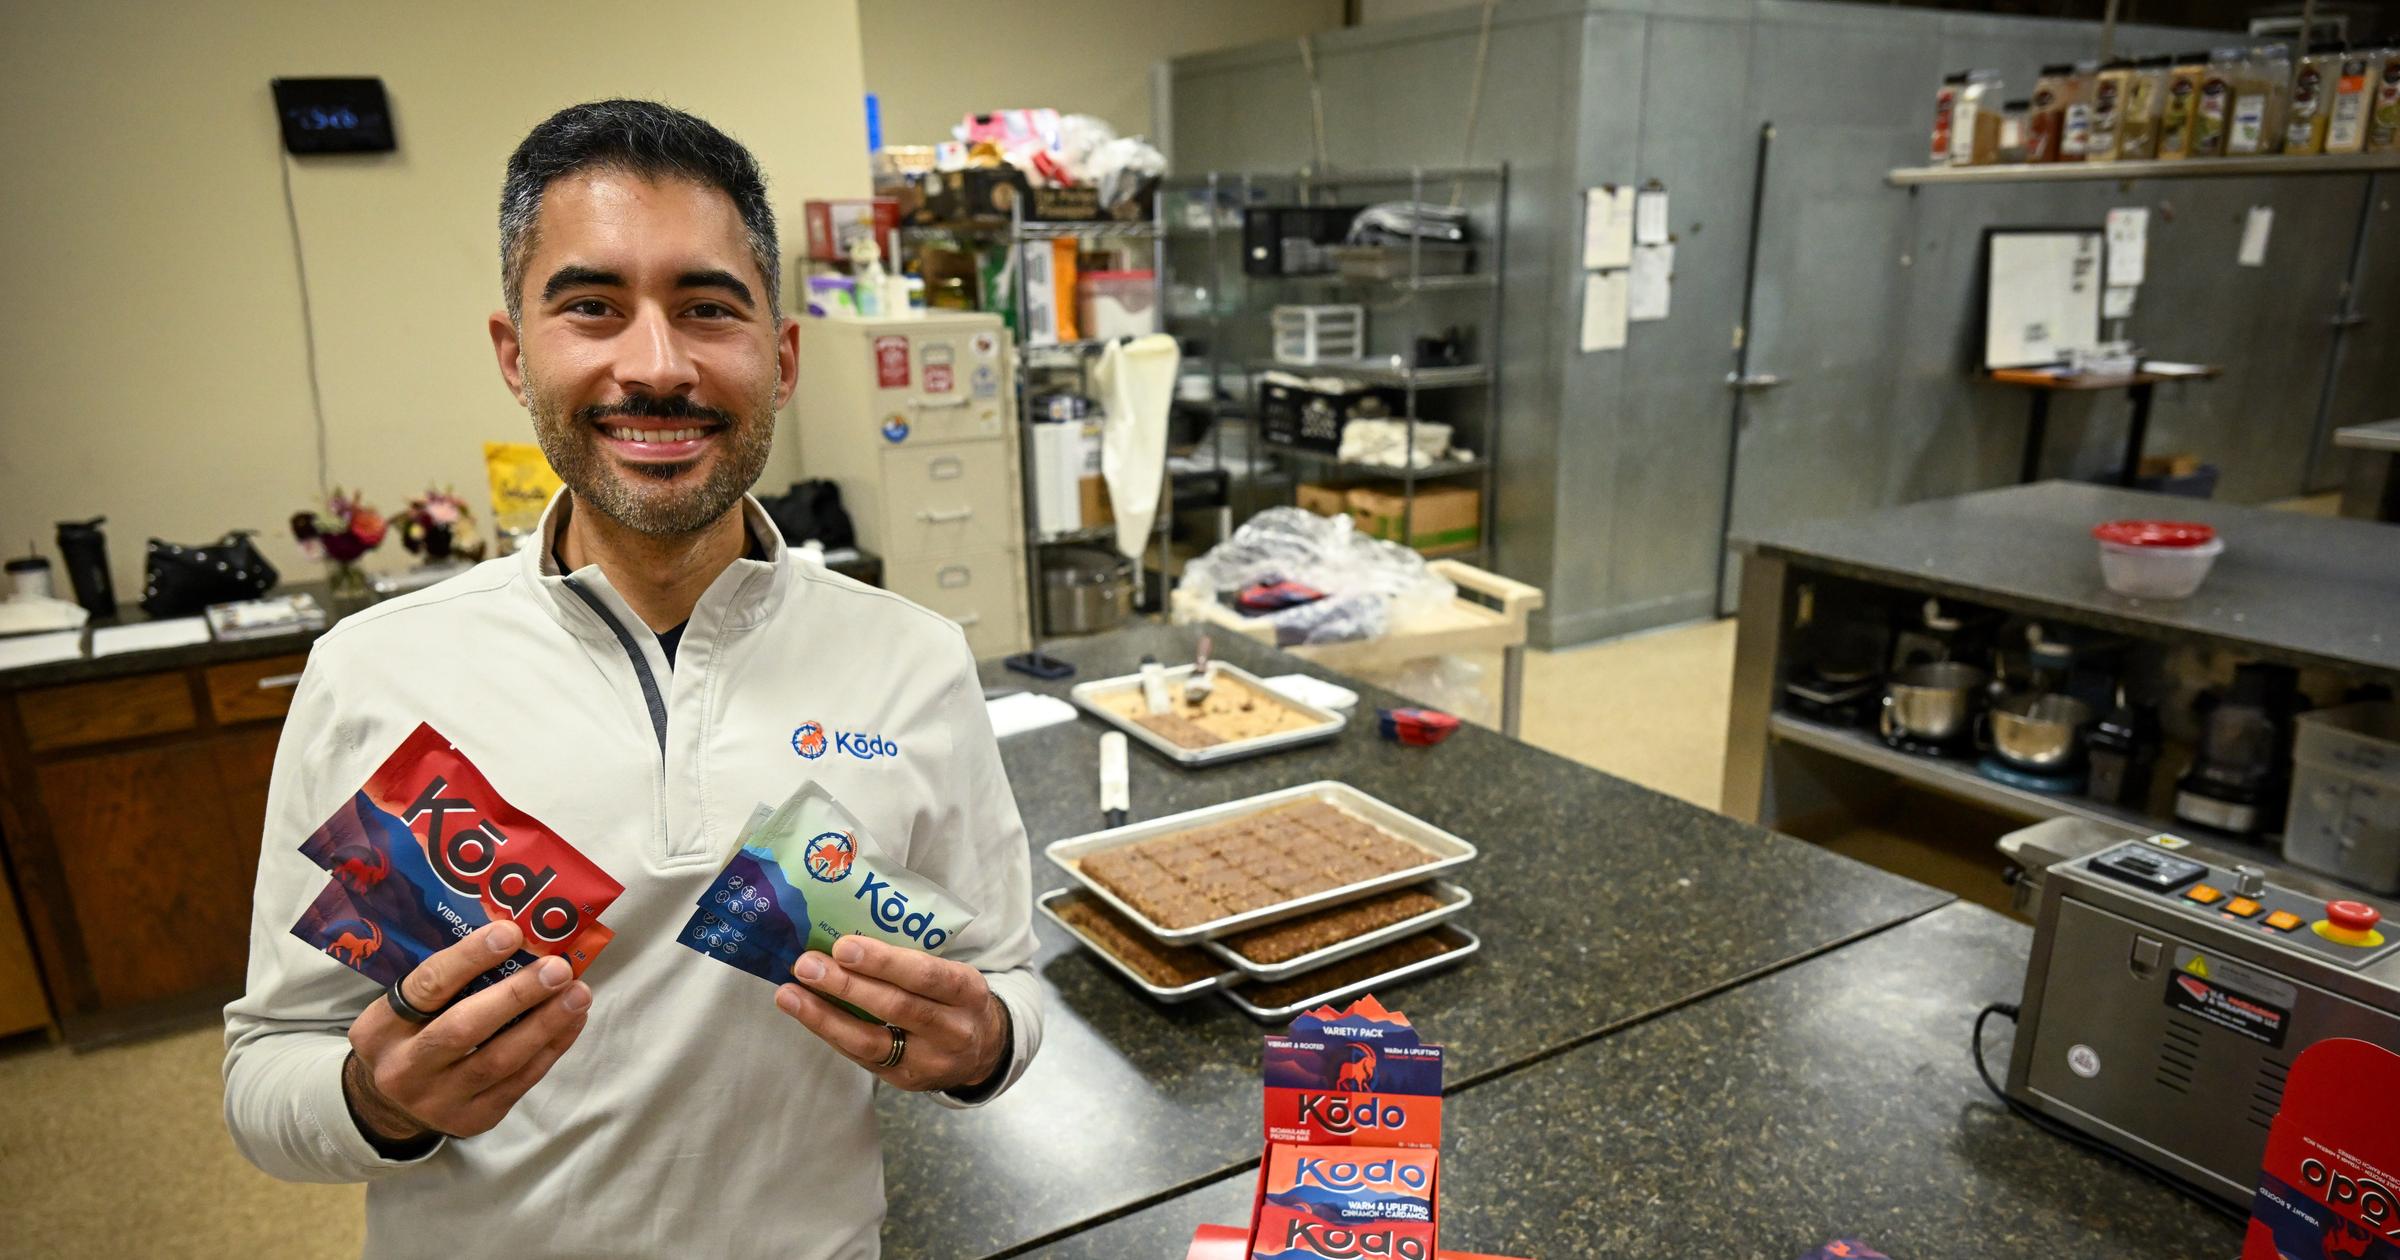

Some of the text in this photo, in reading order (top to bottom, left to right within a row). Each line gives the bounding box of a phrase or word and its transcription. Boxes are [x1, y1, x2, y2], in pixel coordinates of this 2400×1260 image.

[834, 731, 898, 759] Kōdo
[400, 775, 579, 942] Kōdo
[436, 902, 476, 936] VIBRAN
[854, 871, 947, 950] Kōdo
[1322, 1026, 1384, 1038] VARIETY PACK
[1267, 1040, 1293, 1049] VIBRANT
[1300, 1042, 1325, 1051] ROOTED
[1384, 1047, 1403, 1055] WARM
[1409, 1048, 1440, 1057] UPLIFTING
[1298, 1093, 1407, 1136] Kōdo
[2260, 1187, 2285, 1207] ROOTED
[1341, 1209, 1379, 1217] CINNAMON
[1348, 1201, 1429, 1215] WARM & UPLIFTING
[2292, 1207, 2319, 1227] VIBRANT
